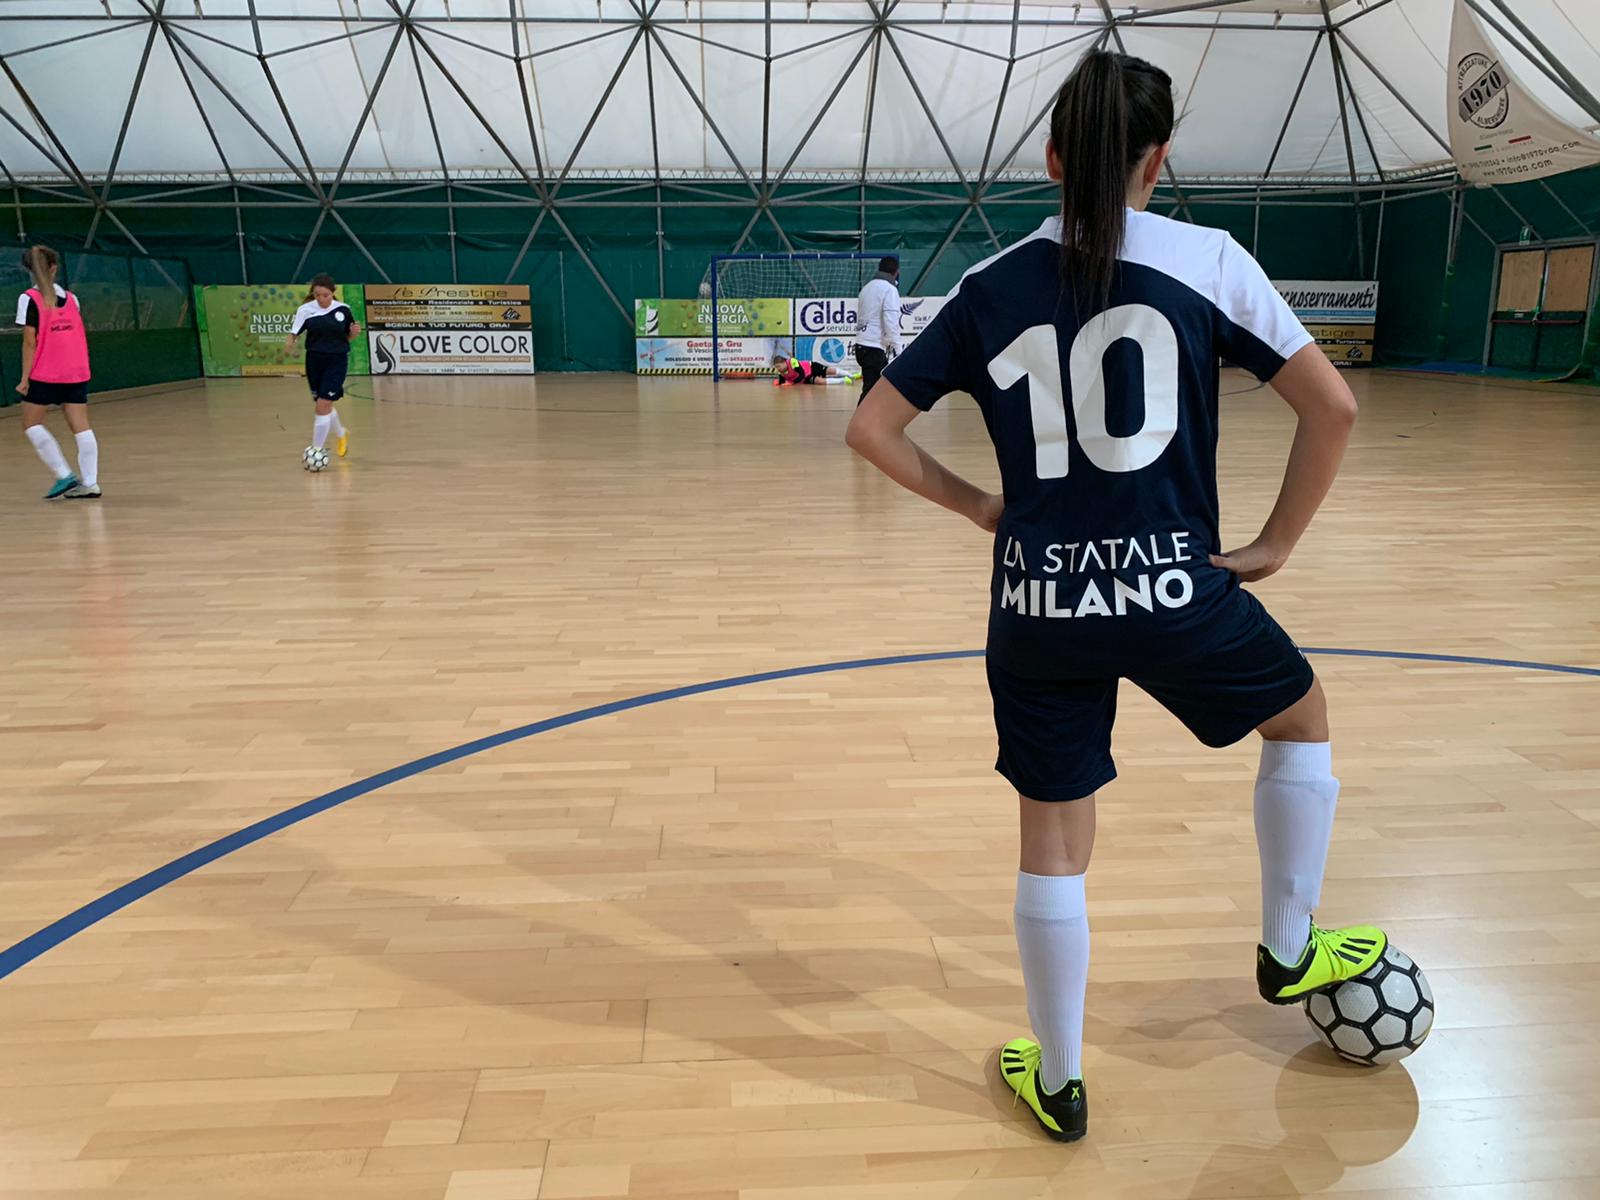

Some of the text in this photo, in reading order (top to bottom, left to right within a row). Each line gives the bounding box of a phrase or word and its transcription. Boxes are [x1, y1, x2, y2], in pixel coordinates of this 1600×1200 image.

[1462, 70, 1502, 114] 1970
[418, 286, 508, 299] Prestige
[1275, 284, 1376, 309] cnoserramenti
[249, 323, 292, 334] ENERG
[800, 301, 858, 333] Calda
[400, 335, 529, 354] LOVE COLOR
[687, 340, 742, 348] Gaetao Gru
[987, 303, 1179, 480] 10
[1003, 531, 1192, 573] LA STATALE
[1001, 568, 1194, 618] MILANO
